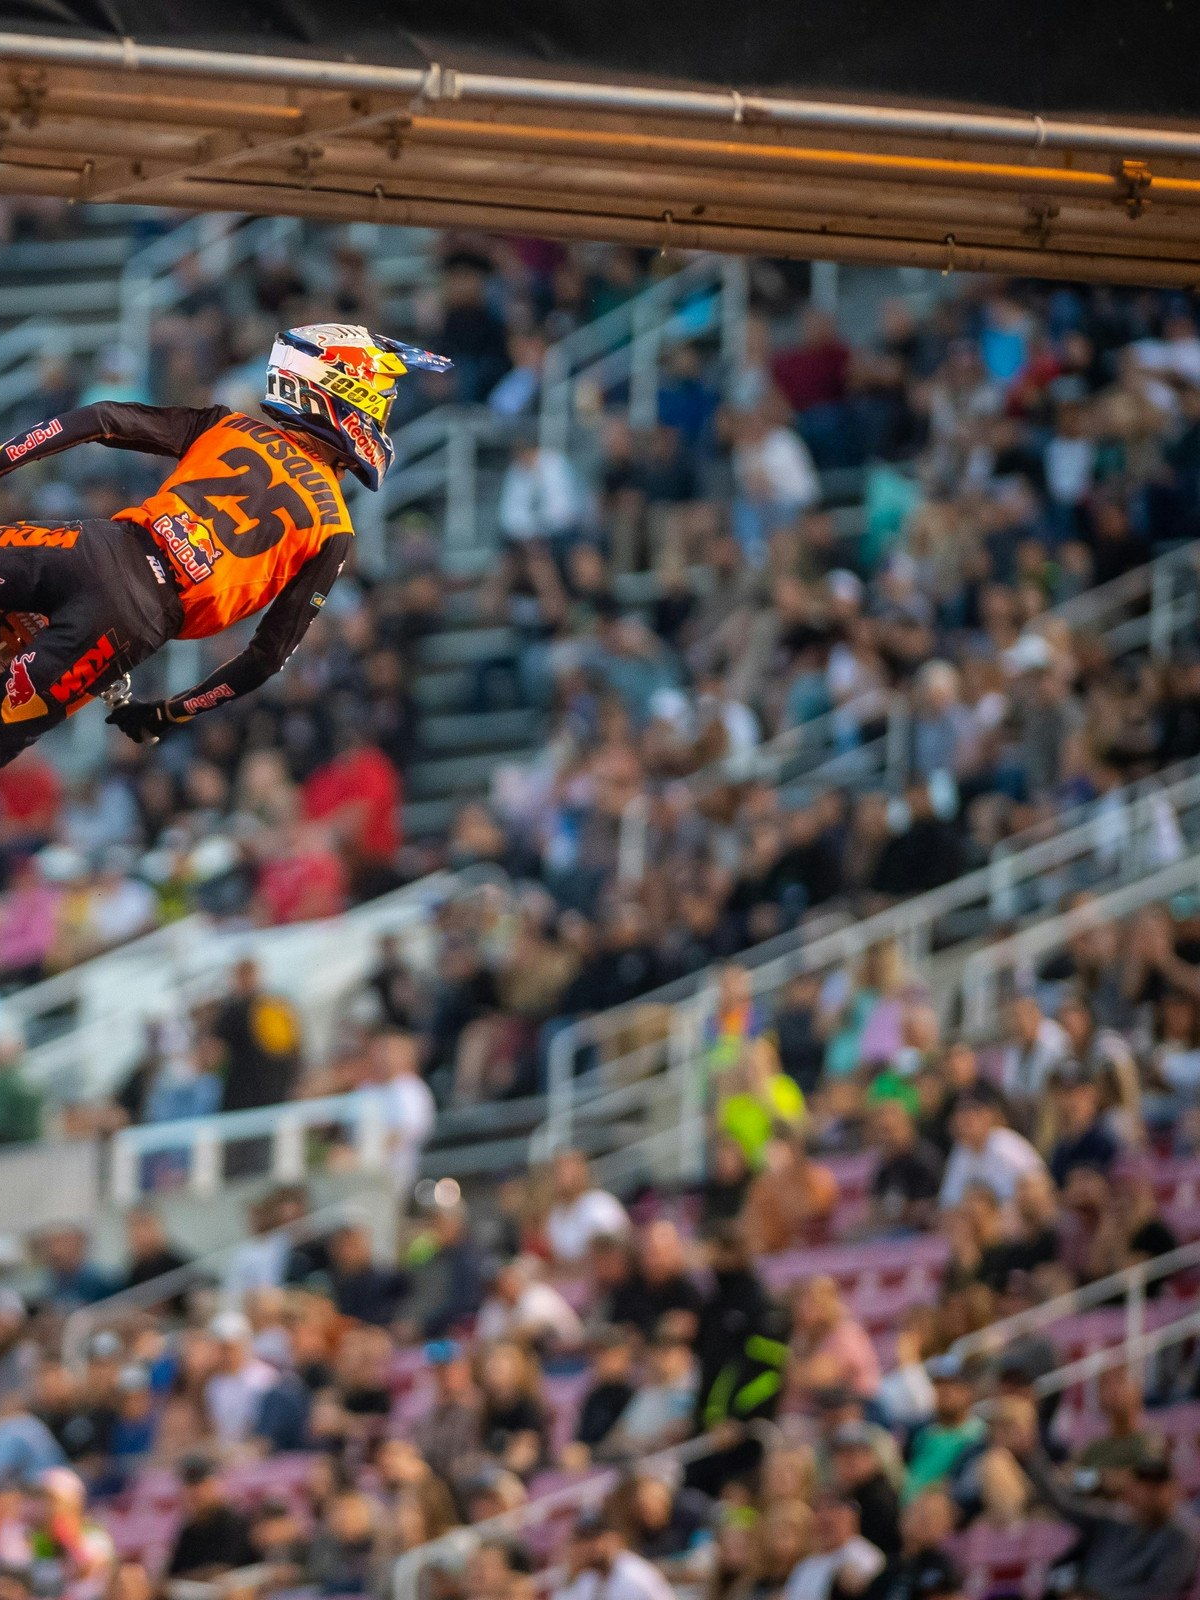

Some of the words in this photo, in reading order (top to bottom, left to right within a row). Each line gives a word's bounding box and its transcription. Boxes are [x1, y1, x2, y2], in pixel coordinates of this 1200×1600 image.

[318, 369, 384, 415] 100%
[5, 433, 37, 462] Red
[32, 418, 63, 446] Bull
[169, 446, 315, 559] 25
[145, 555, 166, 584] KTM
[153, 515, 189, 554] Red
[176, 544, 212, 583] Bull
[49, 633, 115, 704] KTM
[183, 694, 212, 715] Bull
[205, 682, 236, 706] Red
